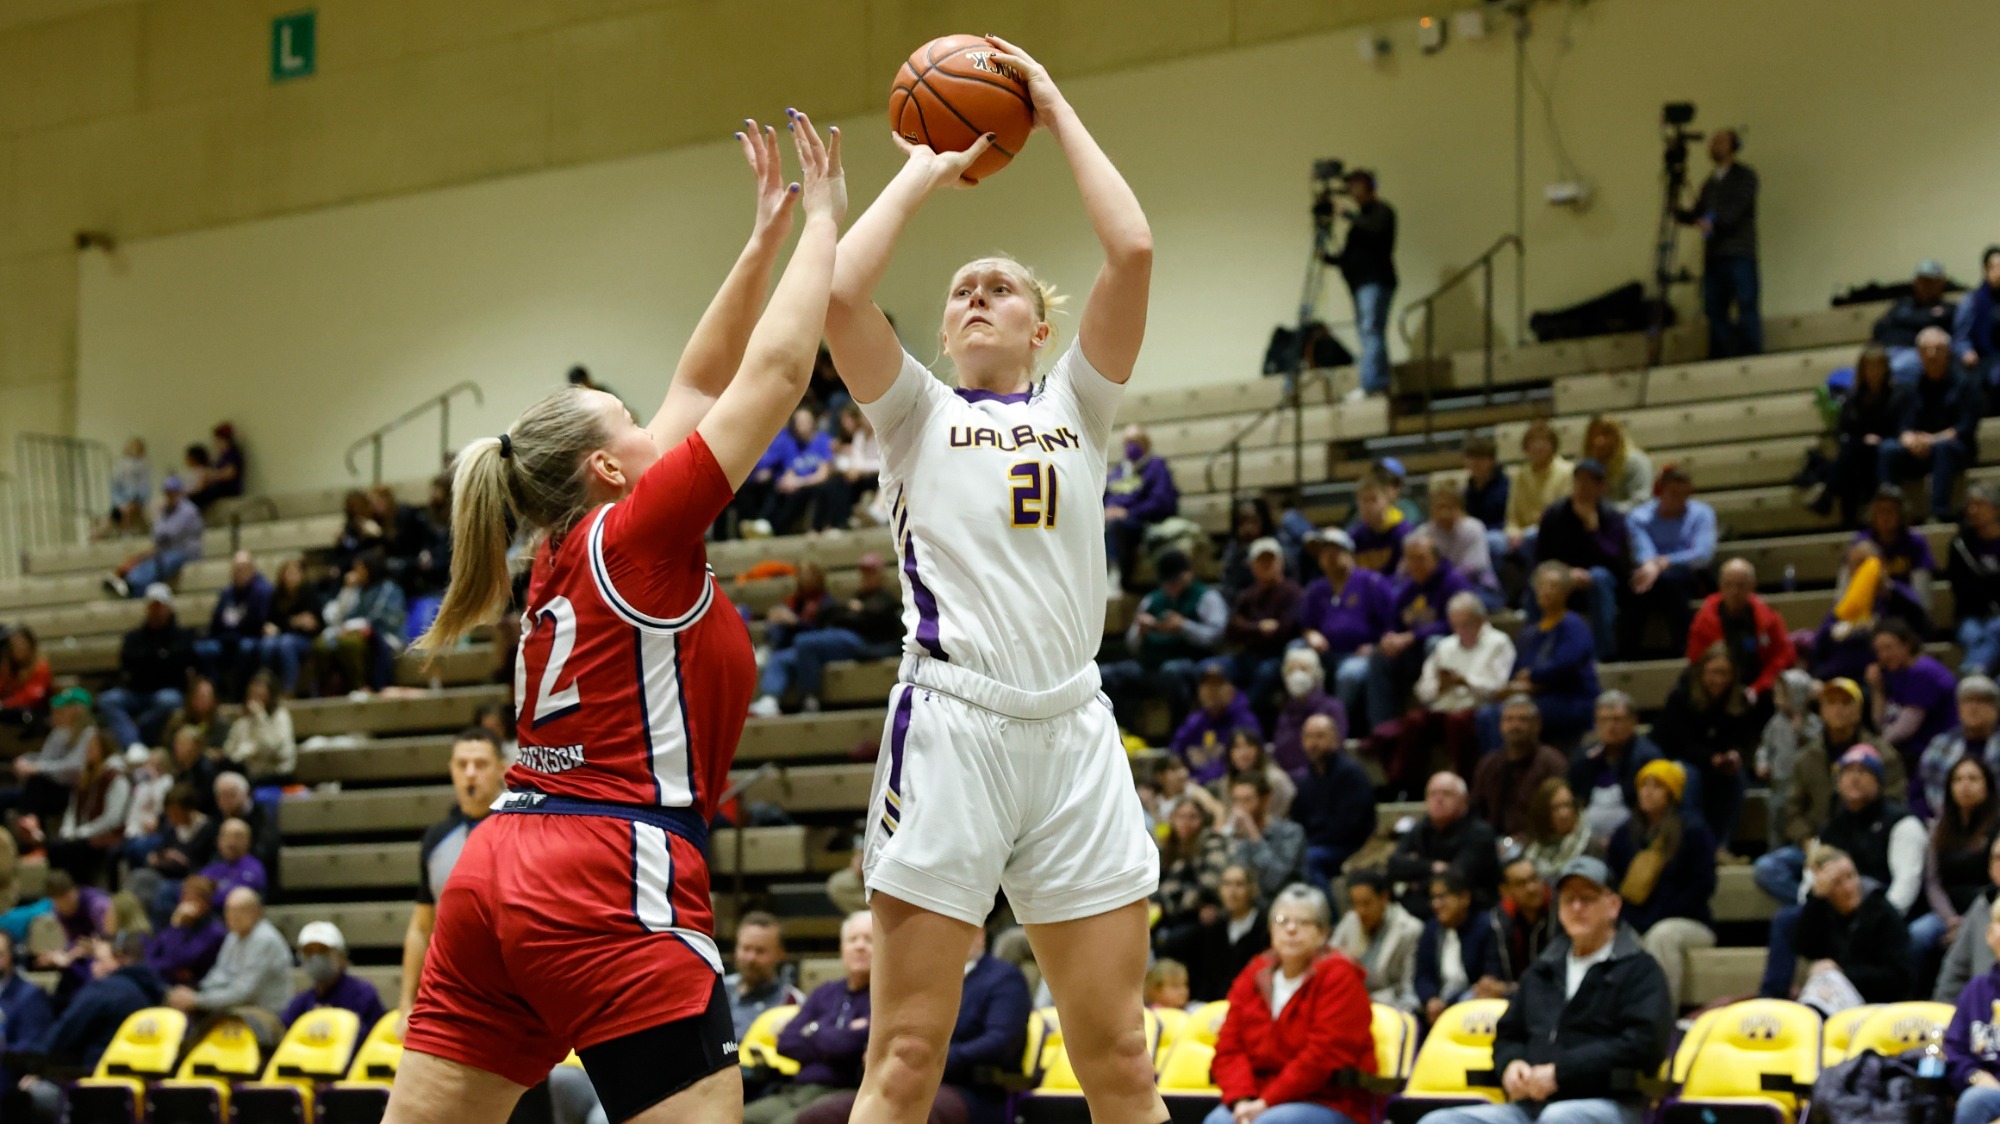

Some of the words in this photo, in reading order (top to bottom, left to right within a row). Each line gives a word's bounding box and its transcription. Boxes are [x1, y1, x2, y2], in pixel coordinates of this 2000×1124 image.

[280, 24, 304, 69] L
[949, 424, 1081, 453] UALBNY
[1008, 460, 1059, 530] 21
